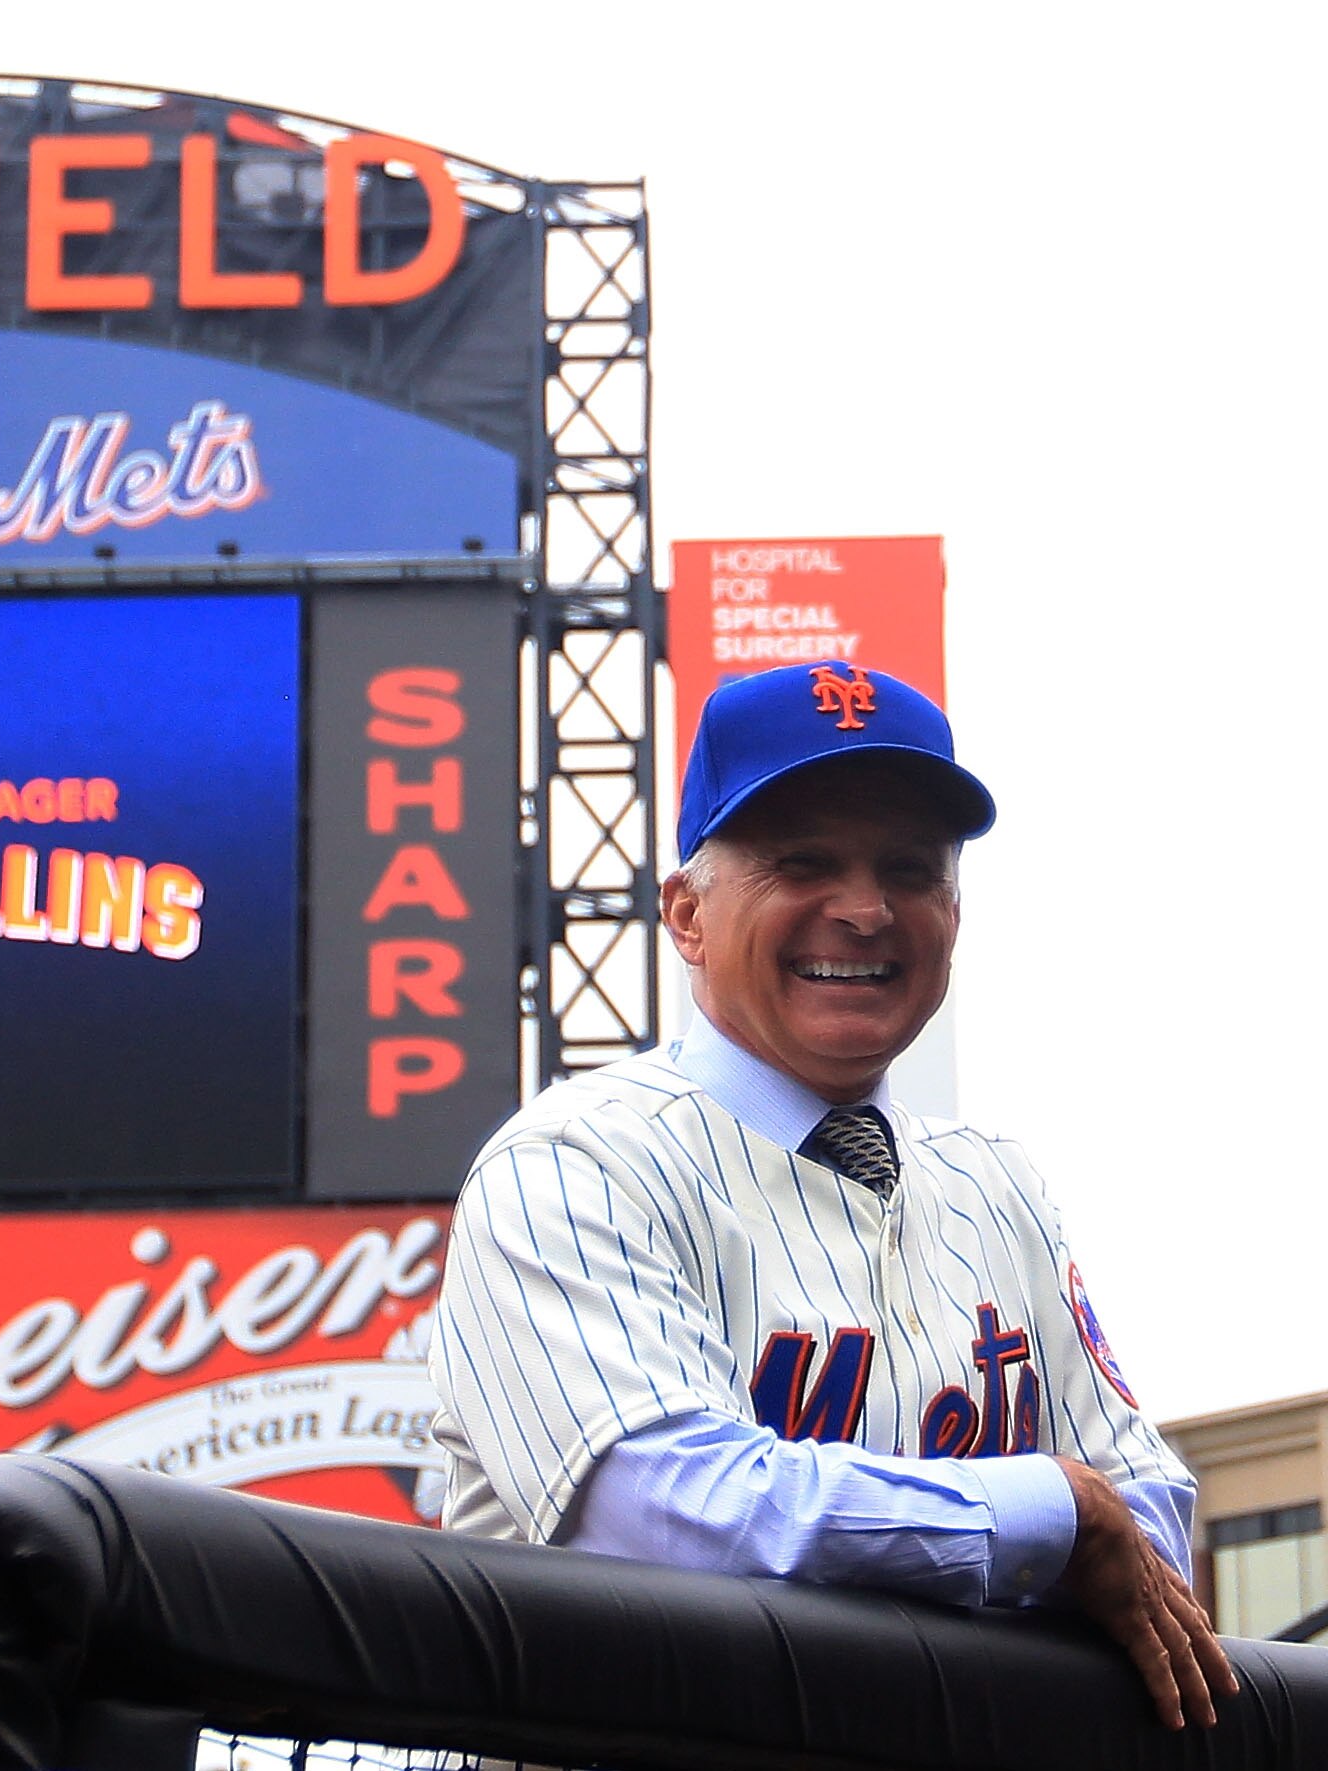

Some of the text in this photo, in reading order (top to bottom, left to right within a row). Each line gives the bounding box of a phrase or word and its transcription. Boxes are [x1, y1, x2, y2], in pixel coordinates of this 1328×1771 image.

[710, 548, 843, 573] HOSPITAL
[711, 576, 768, 601] FOR
[712, 606, 840, 631] SPECIAL
[713, 633, 861, 662] SURGERY
[362, 665, 471, 1119] SHARP
[128, 1394, 433, 1474] erican Lag
